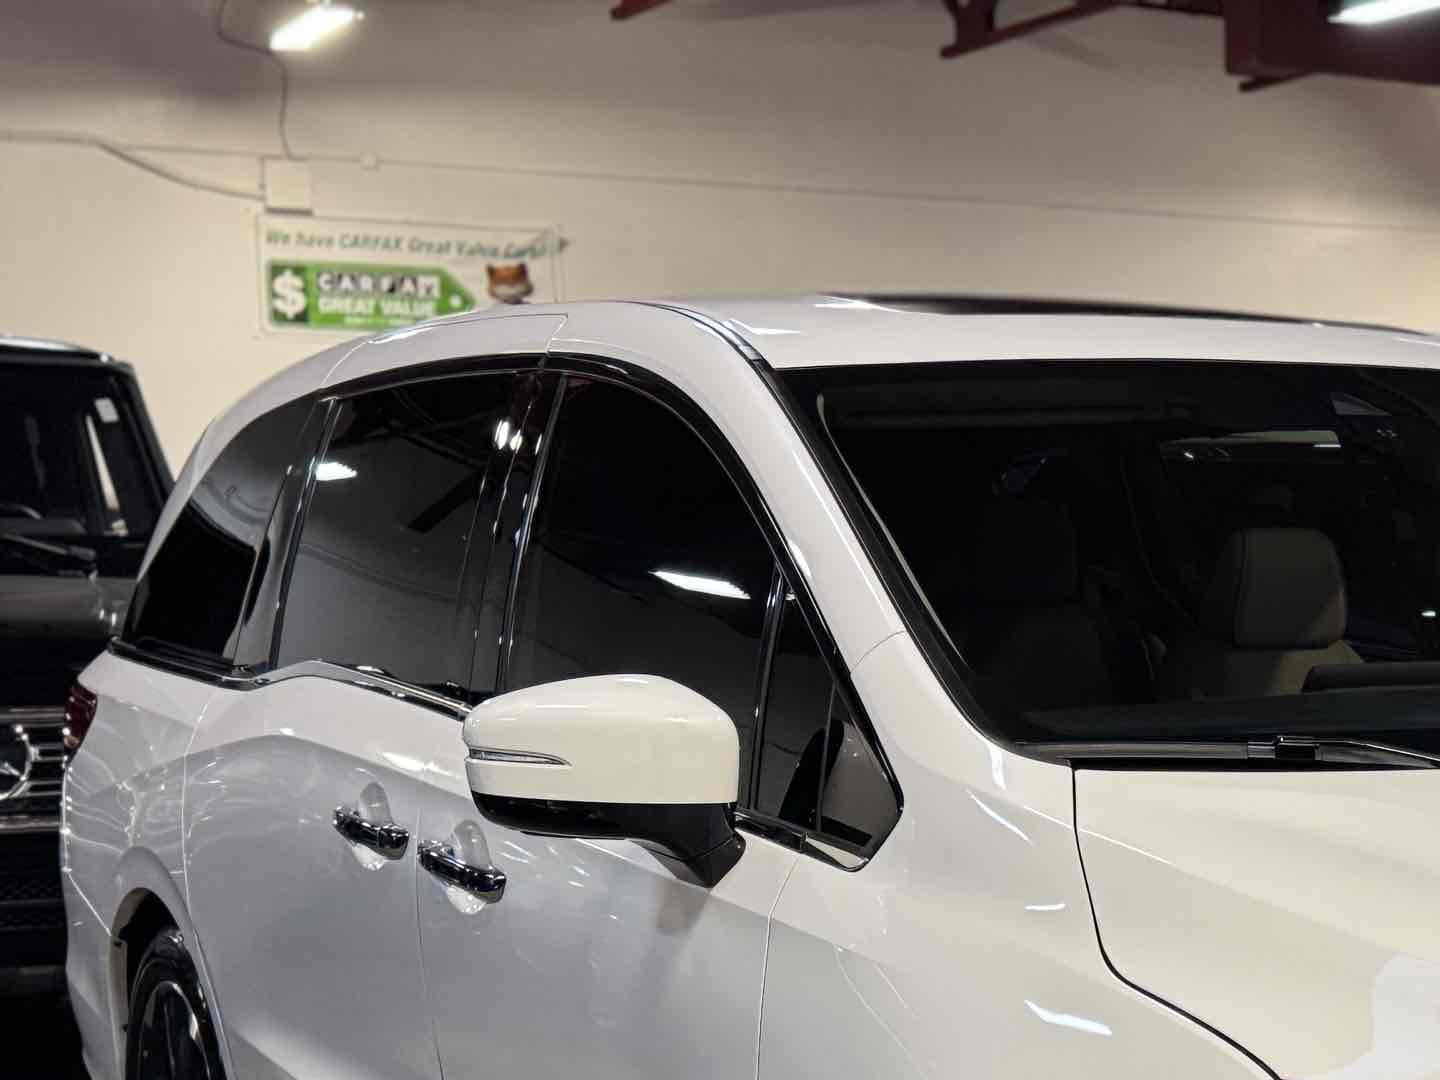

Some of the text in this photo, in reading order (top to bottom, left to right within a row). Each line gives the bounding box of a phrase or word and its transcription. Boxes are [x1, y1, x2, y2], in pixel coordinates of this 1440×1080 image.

[266, 231, 291, 245] We
[296, 232, 334, 248] have
[338, 232, 402, 250] CARFAX
[406, 236, 452, 254] Great
[272, 268, 307, 320] $
